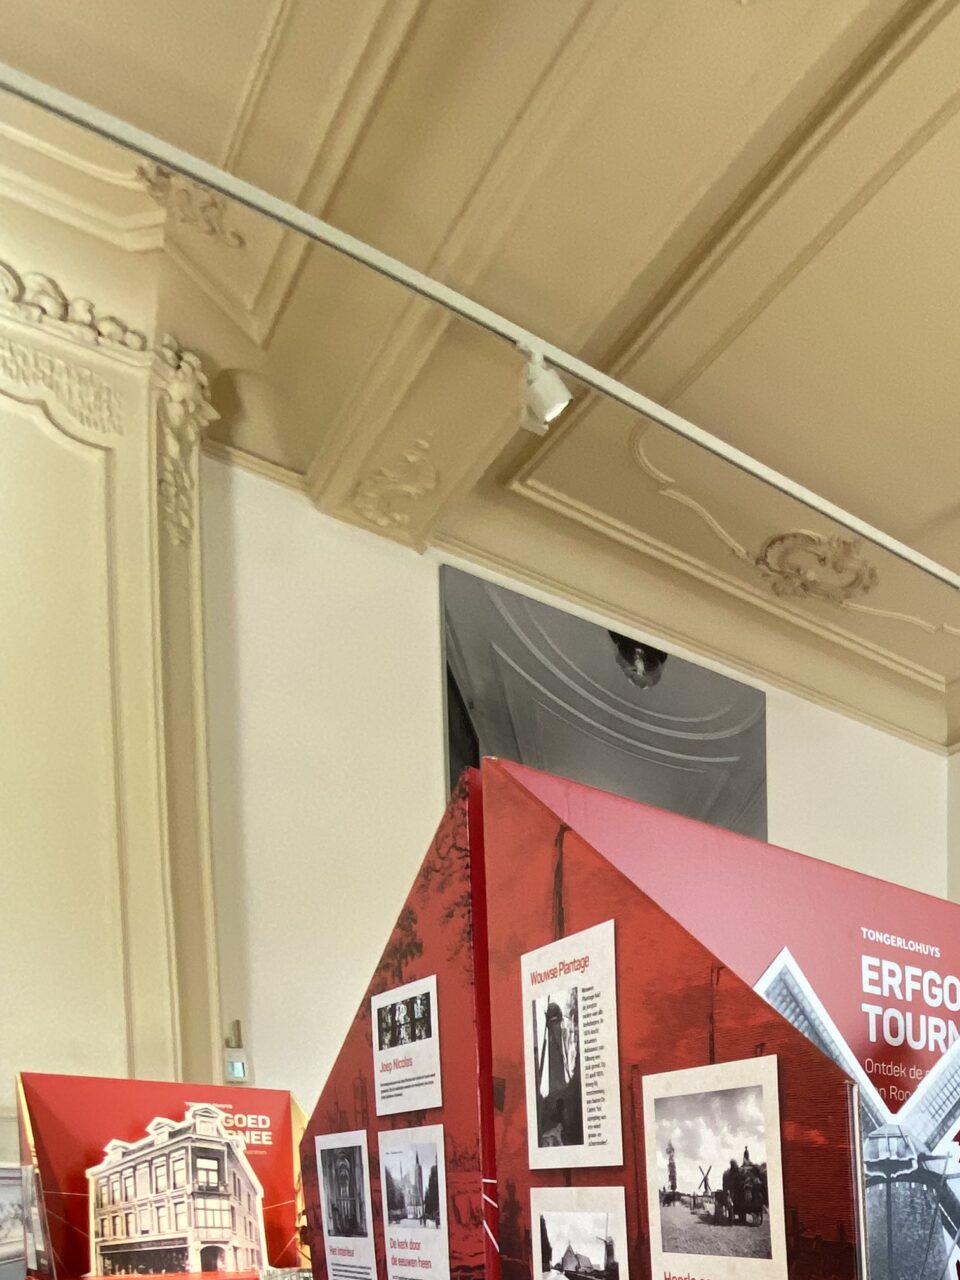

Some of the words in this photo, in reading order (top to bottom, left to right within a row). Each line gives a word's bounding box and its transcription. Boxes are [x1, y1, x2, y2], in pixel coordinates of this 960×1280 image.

[861, 927, 941, 958] TONGERLOHUYS
[530, 965, 558, 987] Wouwse
[558, 954, 590, 976] Plantage
[865, 1057, 908, 1079] Ontdek
[909, 1065, 922, 1080] de
